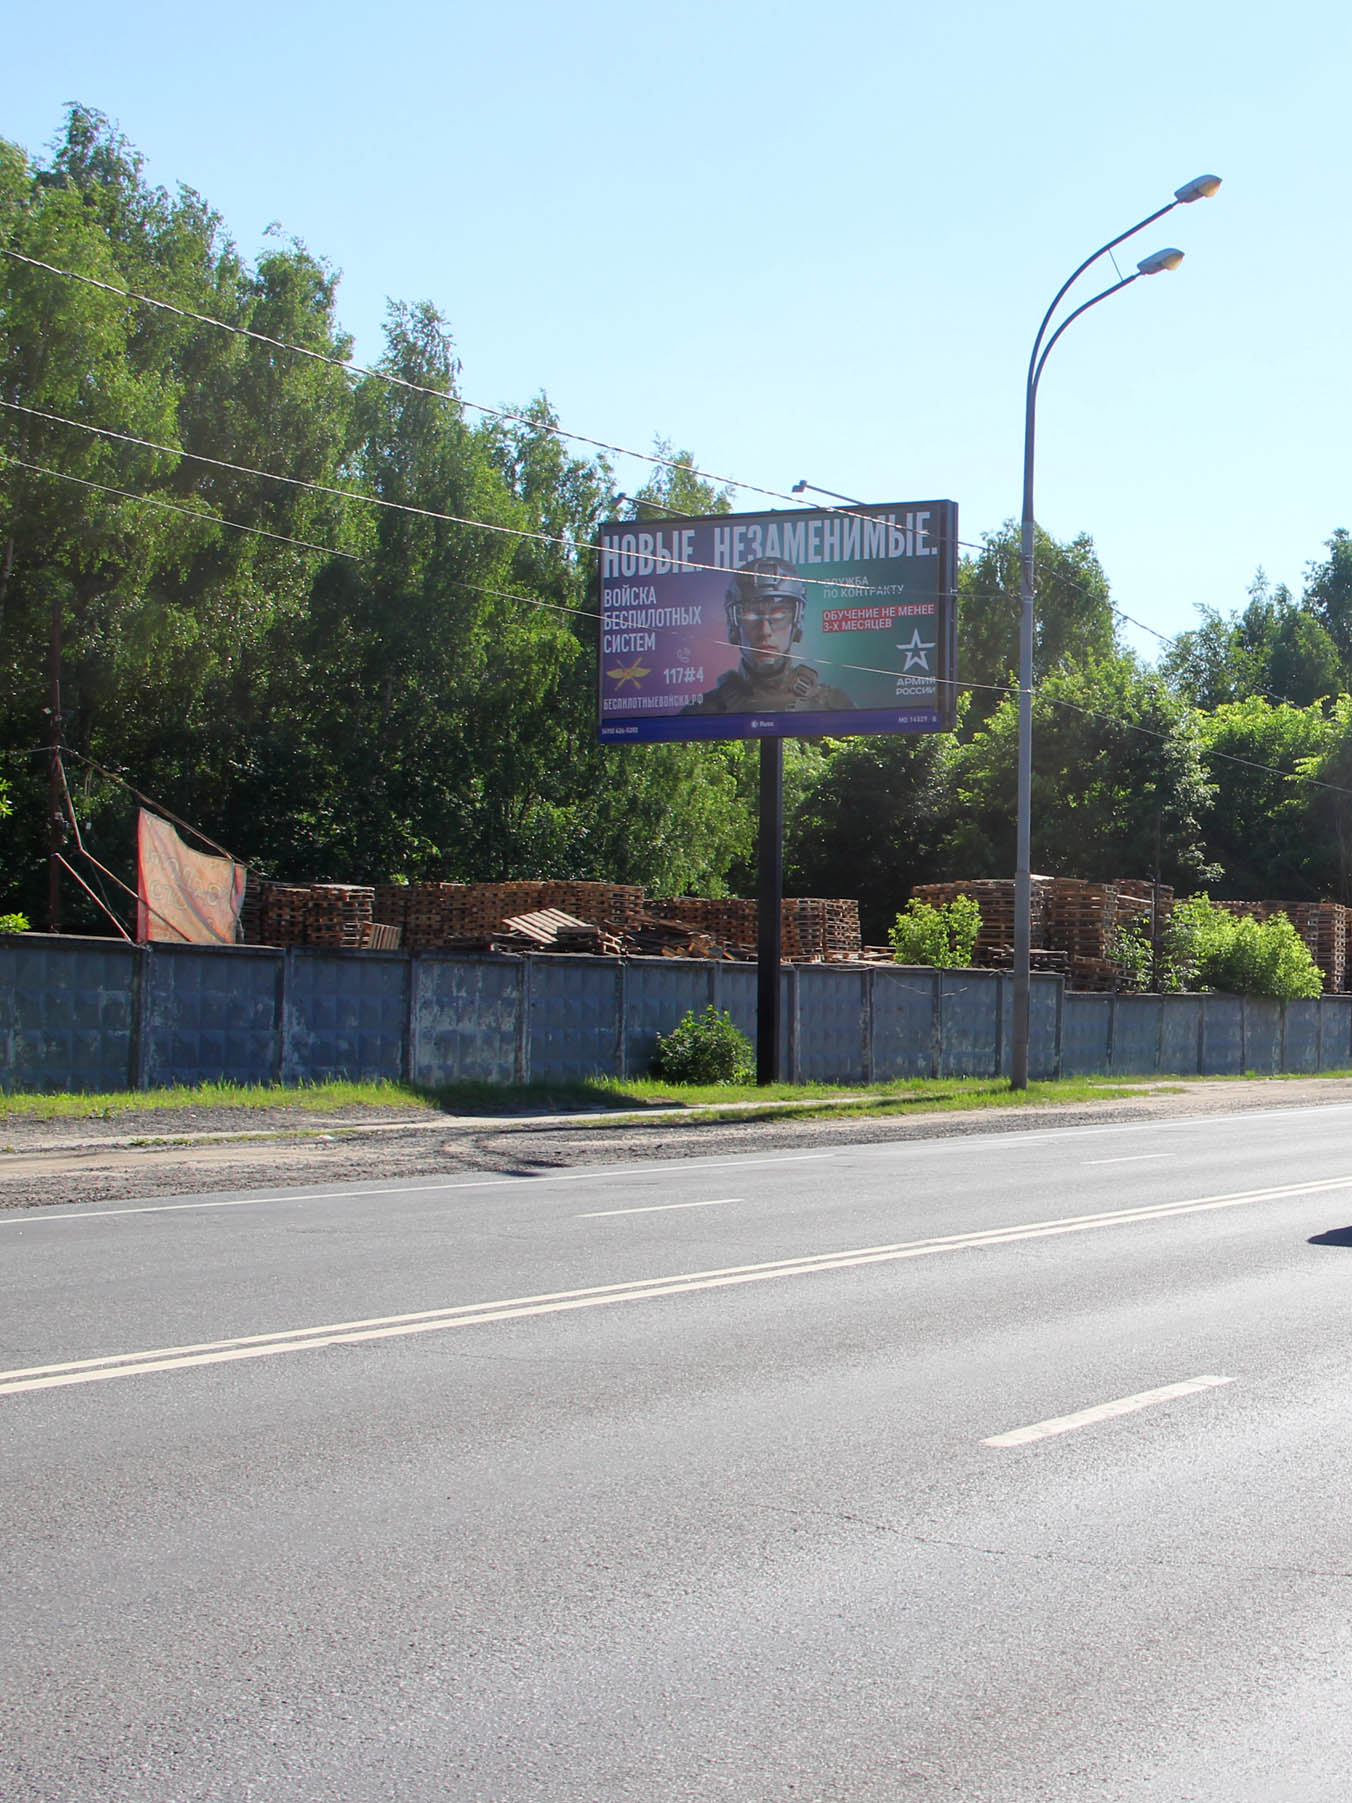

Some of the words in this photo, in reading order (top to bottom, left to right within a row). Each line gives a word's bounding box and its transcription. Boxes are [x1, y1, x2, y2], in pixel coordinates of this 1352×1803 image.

[603, 529, 703, 579] НОВЫЕ.
[713, 511, 938, 570] НЕЗАМЕНИМЫЕ.
[604, 584, 657, 608] ВОЙСКА
[823, 589, 838, 599] ПО
[841, 584, 905, 598] КОНТРАКТУ
[604, 605, 702, 631] БЕСПИЛОТНЫХ
[823, 608, 879, 620] ОБУЧЕНИЕ
[881, 606, 896, 617] НЕ
[898, 604, 935, 616] МЕНЕЕ
[823, 621, 839, 632] 3-Х
[841, 618, 893, 631] МЕСЯЦЕВ
[603, 632, 656, 654] СИСТЕМ
[663, 666, 705, 685] 117#4
[896, 687, 936, 696] РОССИИ
